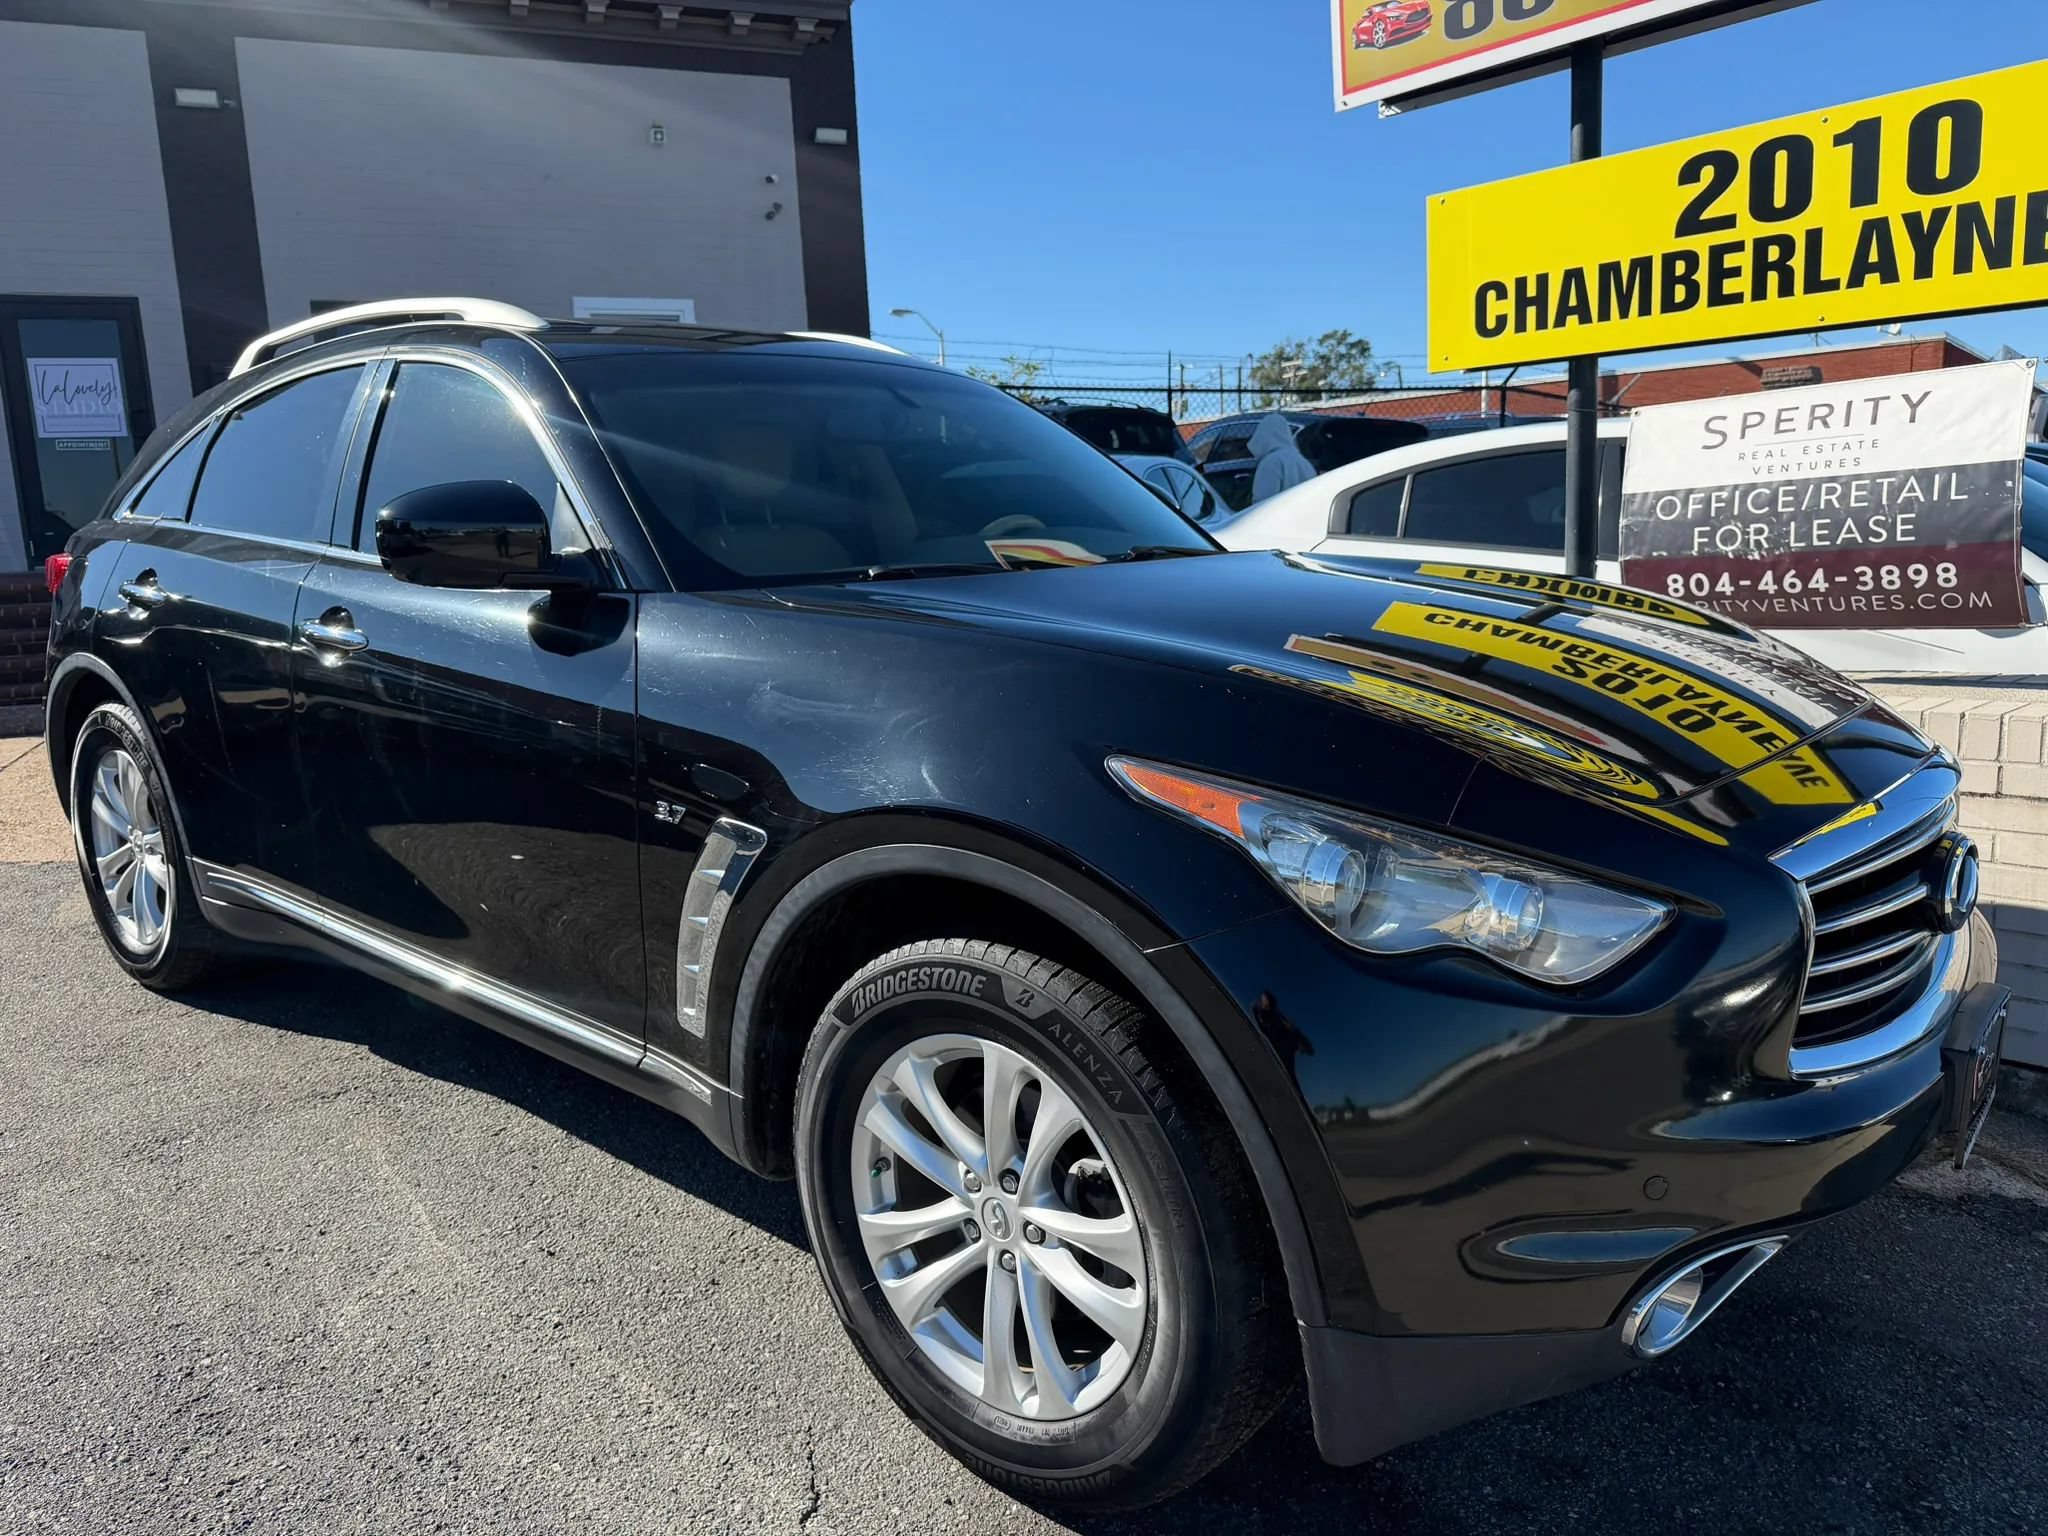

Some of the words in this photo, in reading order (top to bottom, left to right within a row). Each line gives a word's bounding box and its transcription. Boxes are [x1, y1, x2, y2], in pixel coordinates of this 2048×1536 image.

[1675, 99, 1983, 239] 2010
[1475, 191, 2048, 340] CHAMBERLAYNE
[1701, 390, 1933, 450] SPERITY
[1738, 448, 1787, 462] REAL
[1802, 438, 1880, 456] ESTATE
[1752, 456, 1862, 475] VENTURES
[1656, 472, 1968, 521] OFFICE/RETAIL
[1693, 524, 1769, 552] FOR
[1789, 513, 1917, 548] LEASE
[1666, 562, 1958, 598] 804-464-3898
[1695, 591, 1993, 613] RITYVENTURES.COM
[851, 966, 988, 1019] BRIDGESTONE
[1047, 1022, 1124, 1105] ALENZA
